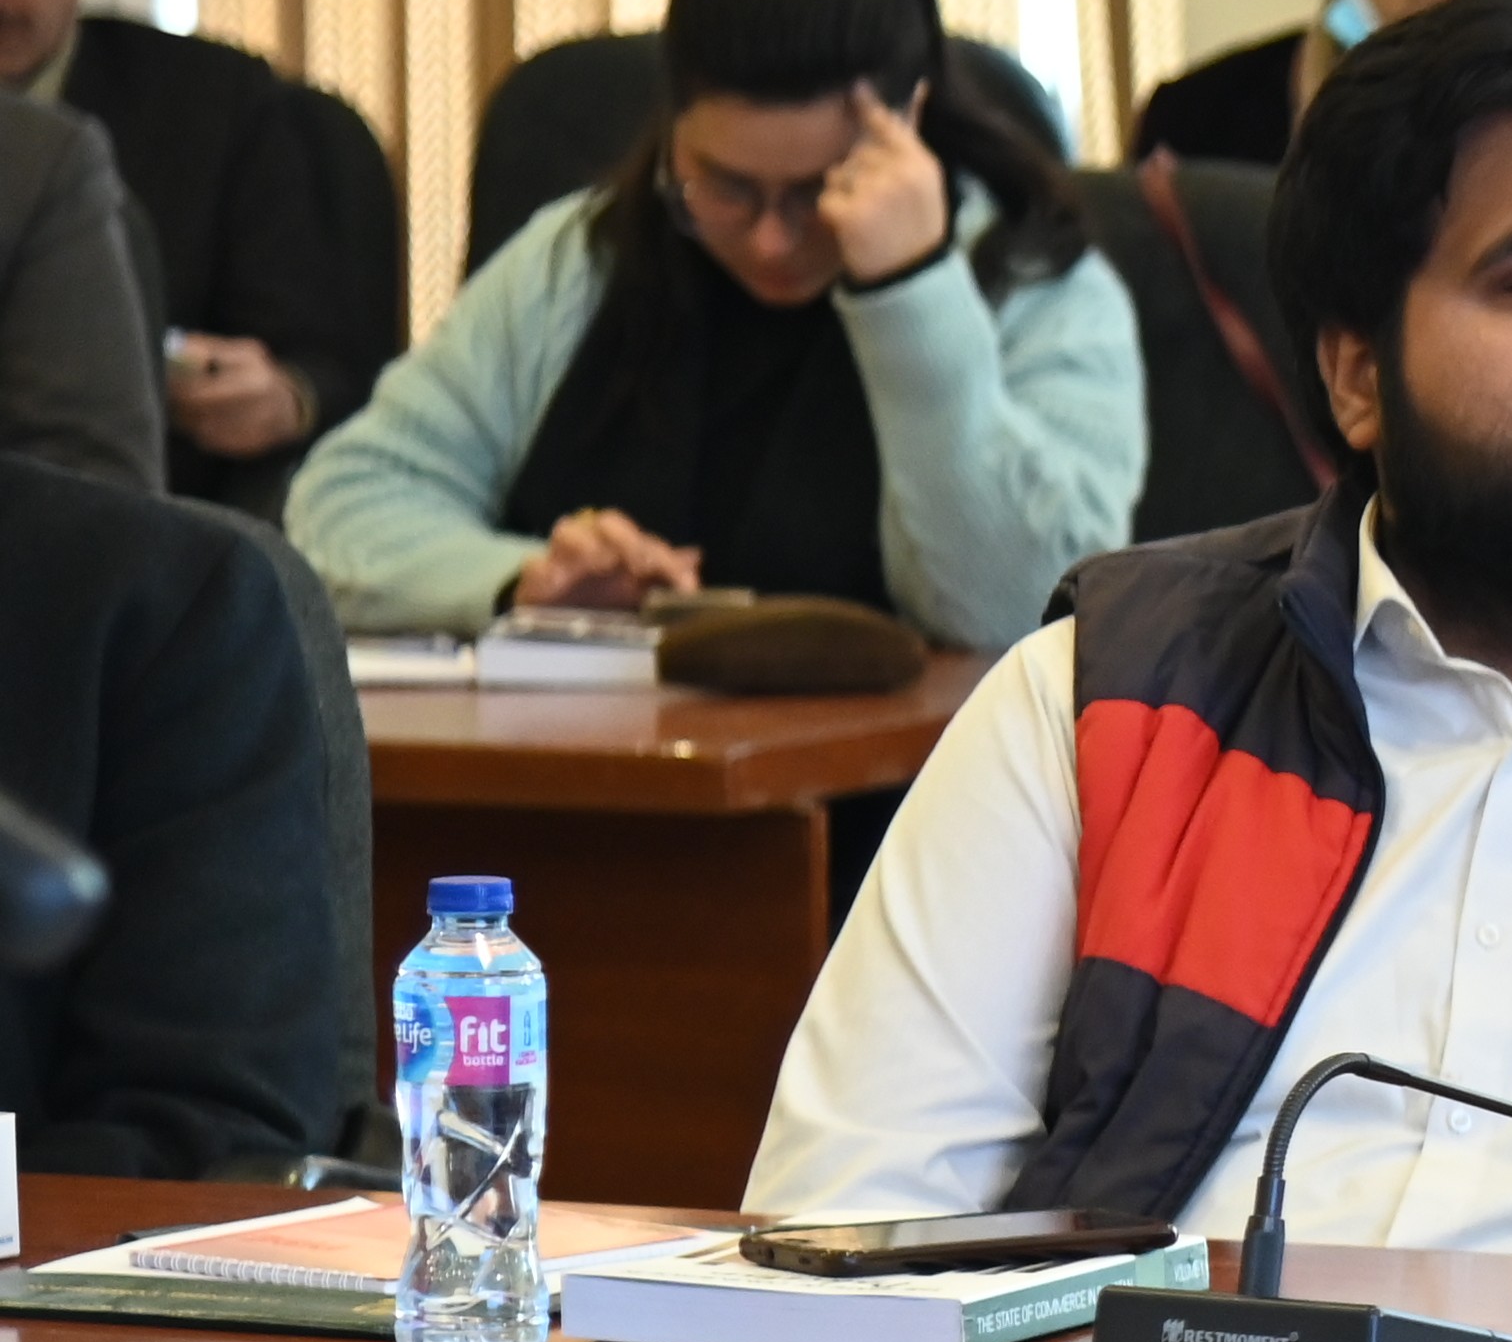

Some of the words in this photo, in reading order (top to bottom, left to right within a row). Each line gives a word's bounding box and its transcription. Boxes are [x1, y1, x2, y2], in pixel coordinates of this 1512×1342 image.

[976, 1313, 995, 1334] THE
[995, 1307, 1021, 1330] STATE
[1021, 1303, 1035, 1324] OF
